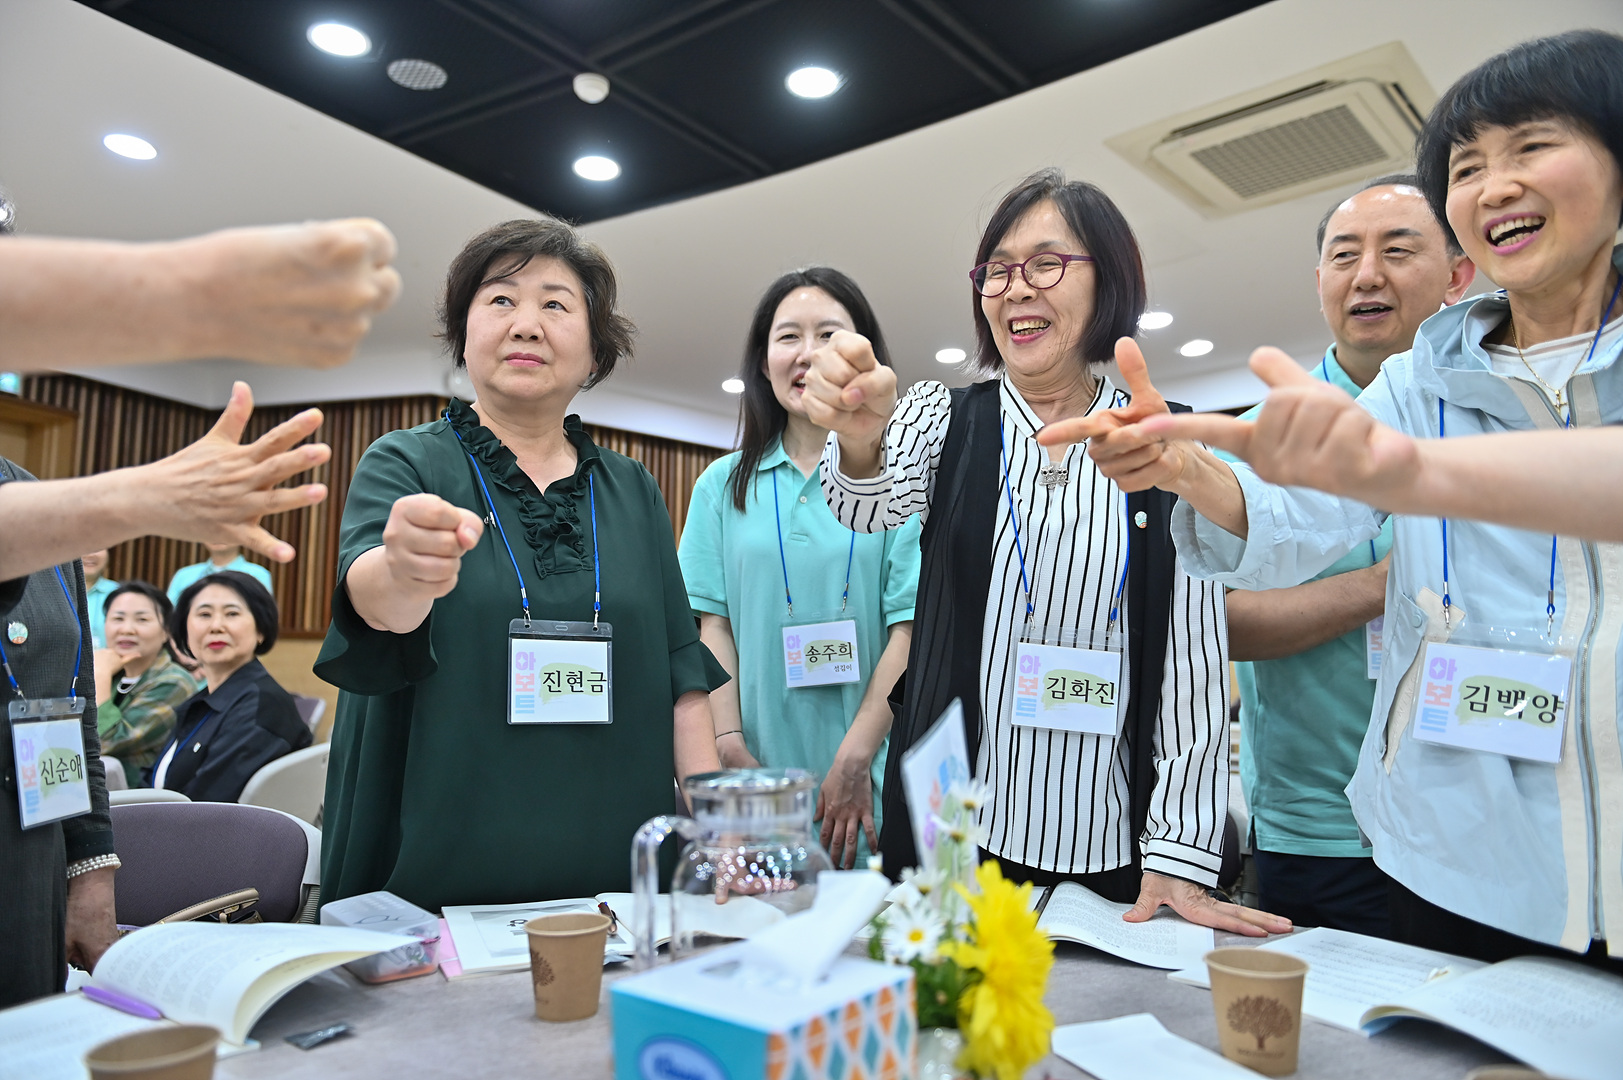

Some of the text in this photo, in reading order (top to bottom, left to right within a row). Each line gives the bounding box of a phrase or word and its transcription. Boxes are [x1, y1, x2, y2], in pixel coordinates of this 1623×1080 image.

[786, 634, 803, 681] 아보트
[805, 641, 852, 663] 송주희
[515, 651, 536, 714] 아보트
[543, 670, 607, 693] 진현금
[1015, 654, 1041, 718] 아보트
[1046, 676, 1115, 705] 김화진
[1420, 656, 1458, 733] 아보트
[1463, 685, 1565, 724] 김백양
[20, 738, 39, 814] 아보트
[41, 754, 83, 785] 신순애
